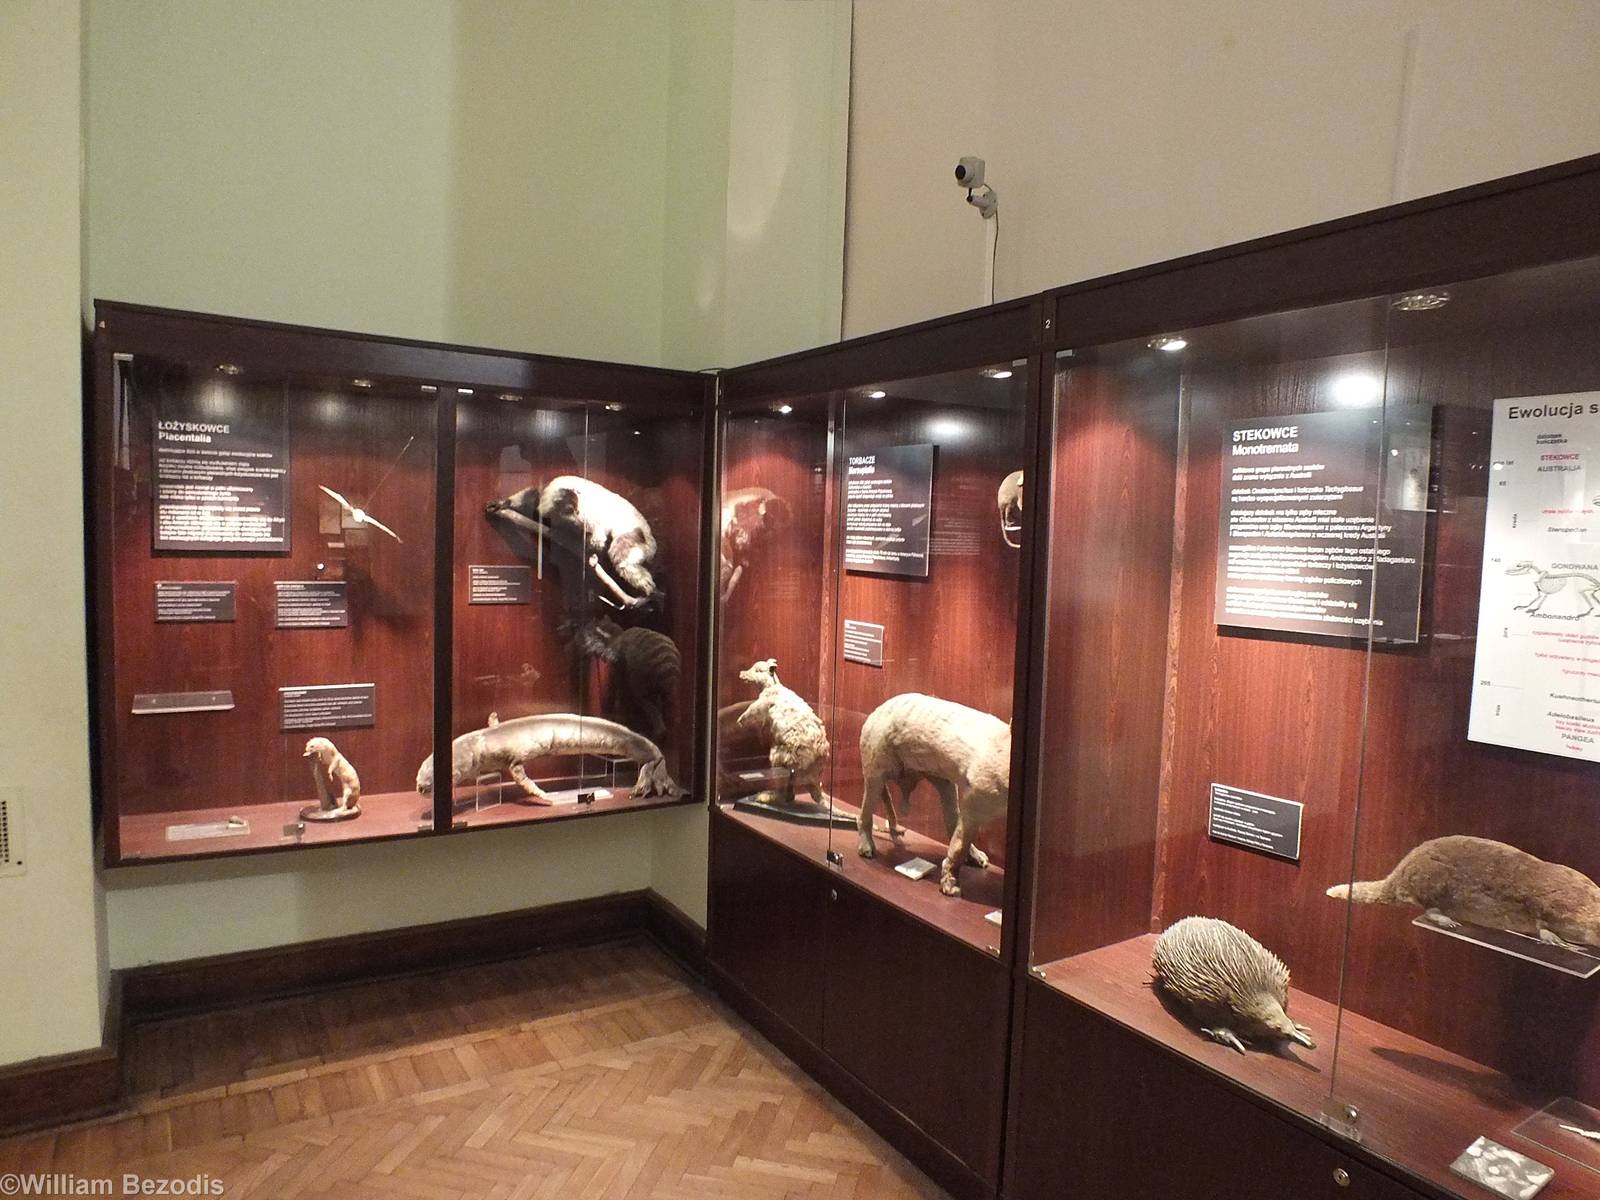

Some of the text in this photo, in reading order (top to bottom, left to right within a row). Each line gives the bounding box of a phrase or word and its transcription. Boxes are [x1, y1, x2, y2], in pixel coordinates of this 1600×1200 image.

[1045, 319, 1051, 329] 2
[1508, 403, 1599, 419] Ewolucja s
[158, 420, 230, 434] ŁOŻYSKOWCE
[158, 431, 212, 443] Placentalia
[1232, 426, 1298, 442] STEKOWCE
[1232, 442, 1299, 456] Monotremata
[849, 455, 876, 465] TORBACZE
[1540, 453, 1580, 461] STEKOWCE
[1561, 733, 1594, 744] PANGEA
